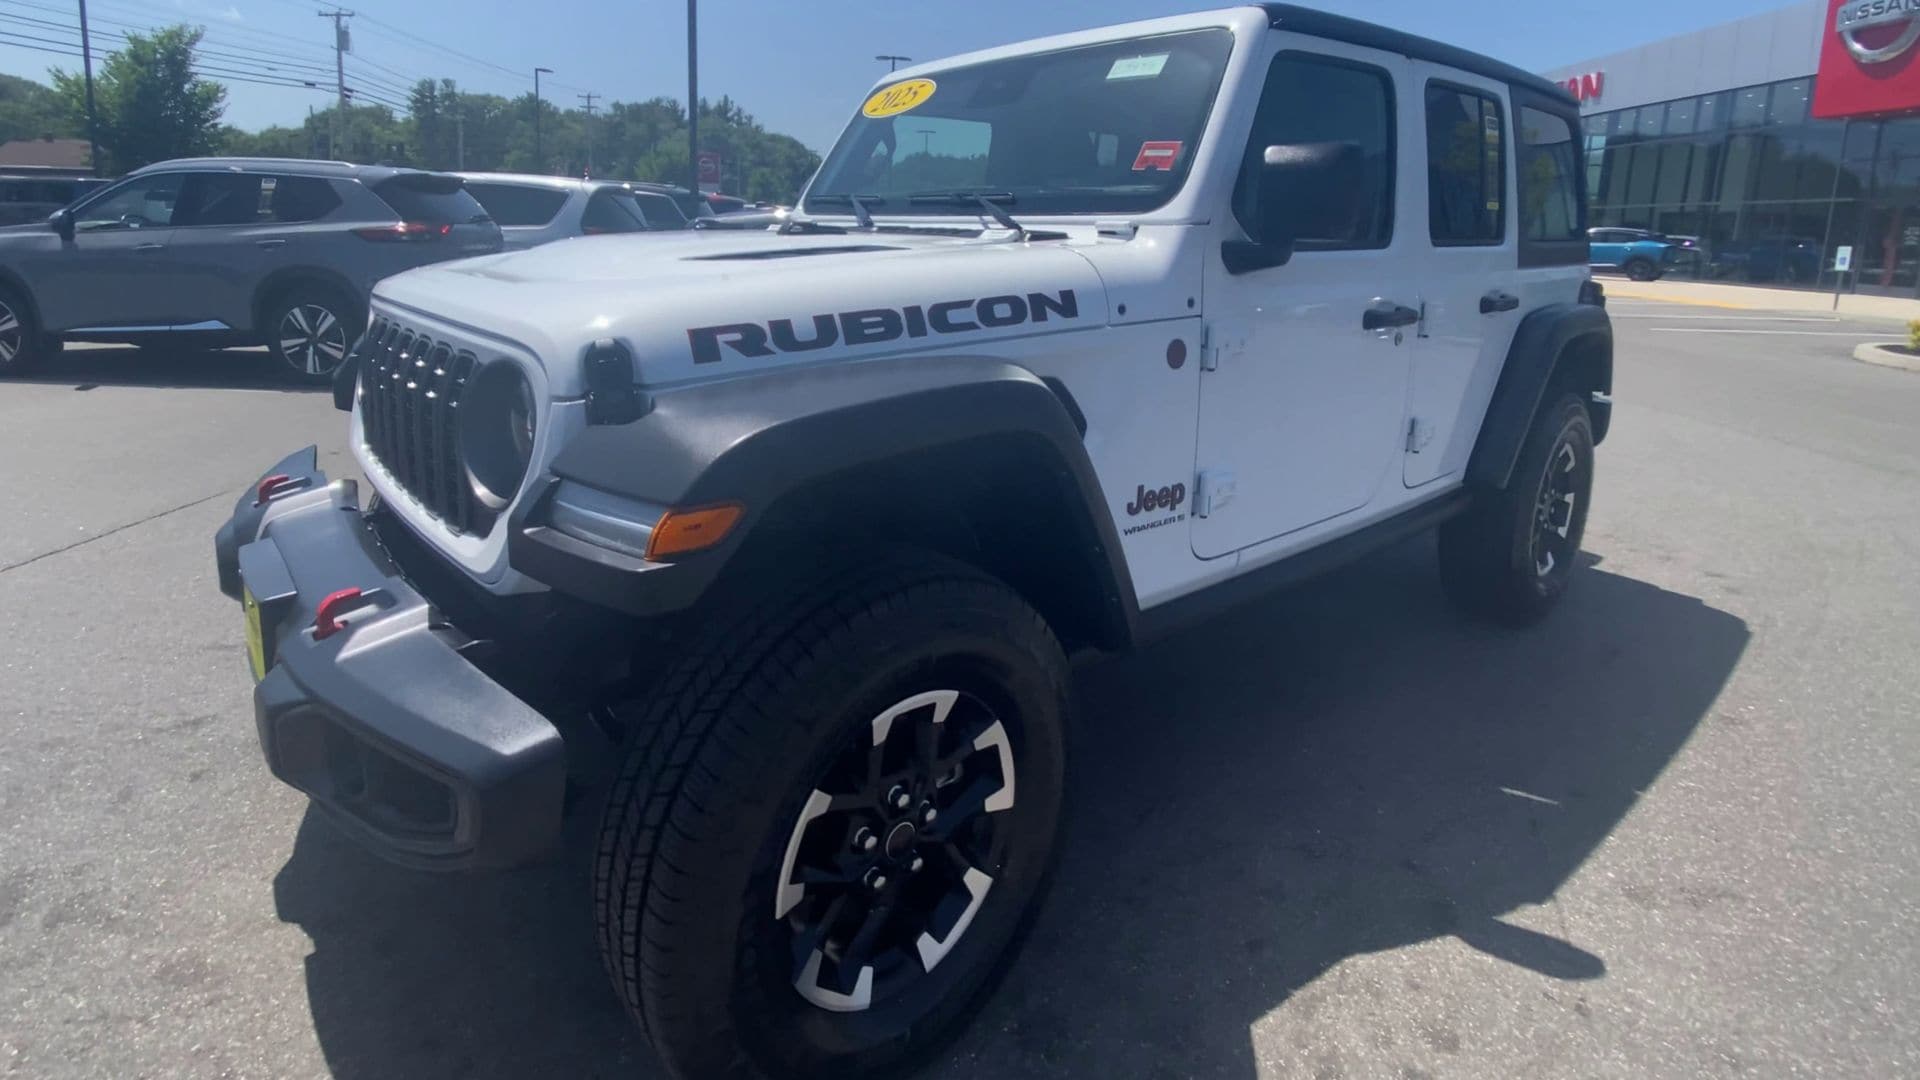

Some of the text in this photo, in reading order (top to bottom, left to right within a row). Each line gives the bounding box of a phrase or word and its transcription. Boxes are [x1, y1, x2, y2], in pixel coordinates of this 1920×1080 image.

[869, 83, 928, 113] 2025
[687, 289, 1079, 364] RUBICON
[1127, 482, 1186, 516] Jeep
[1123, 516, 1176, 536] WRANGLER
